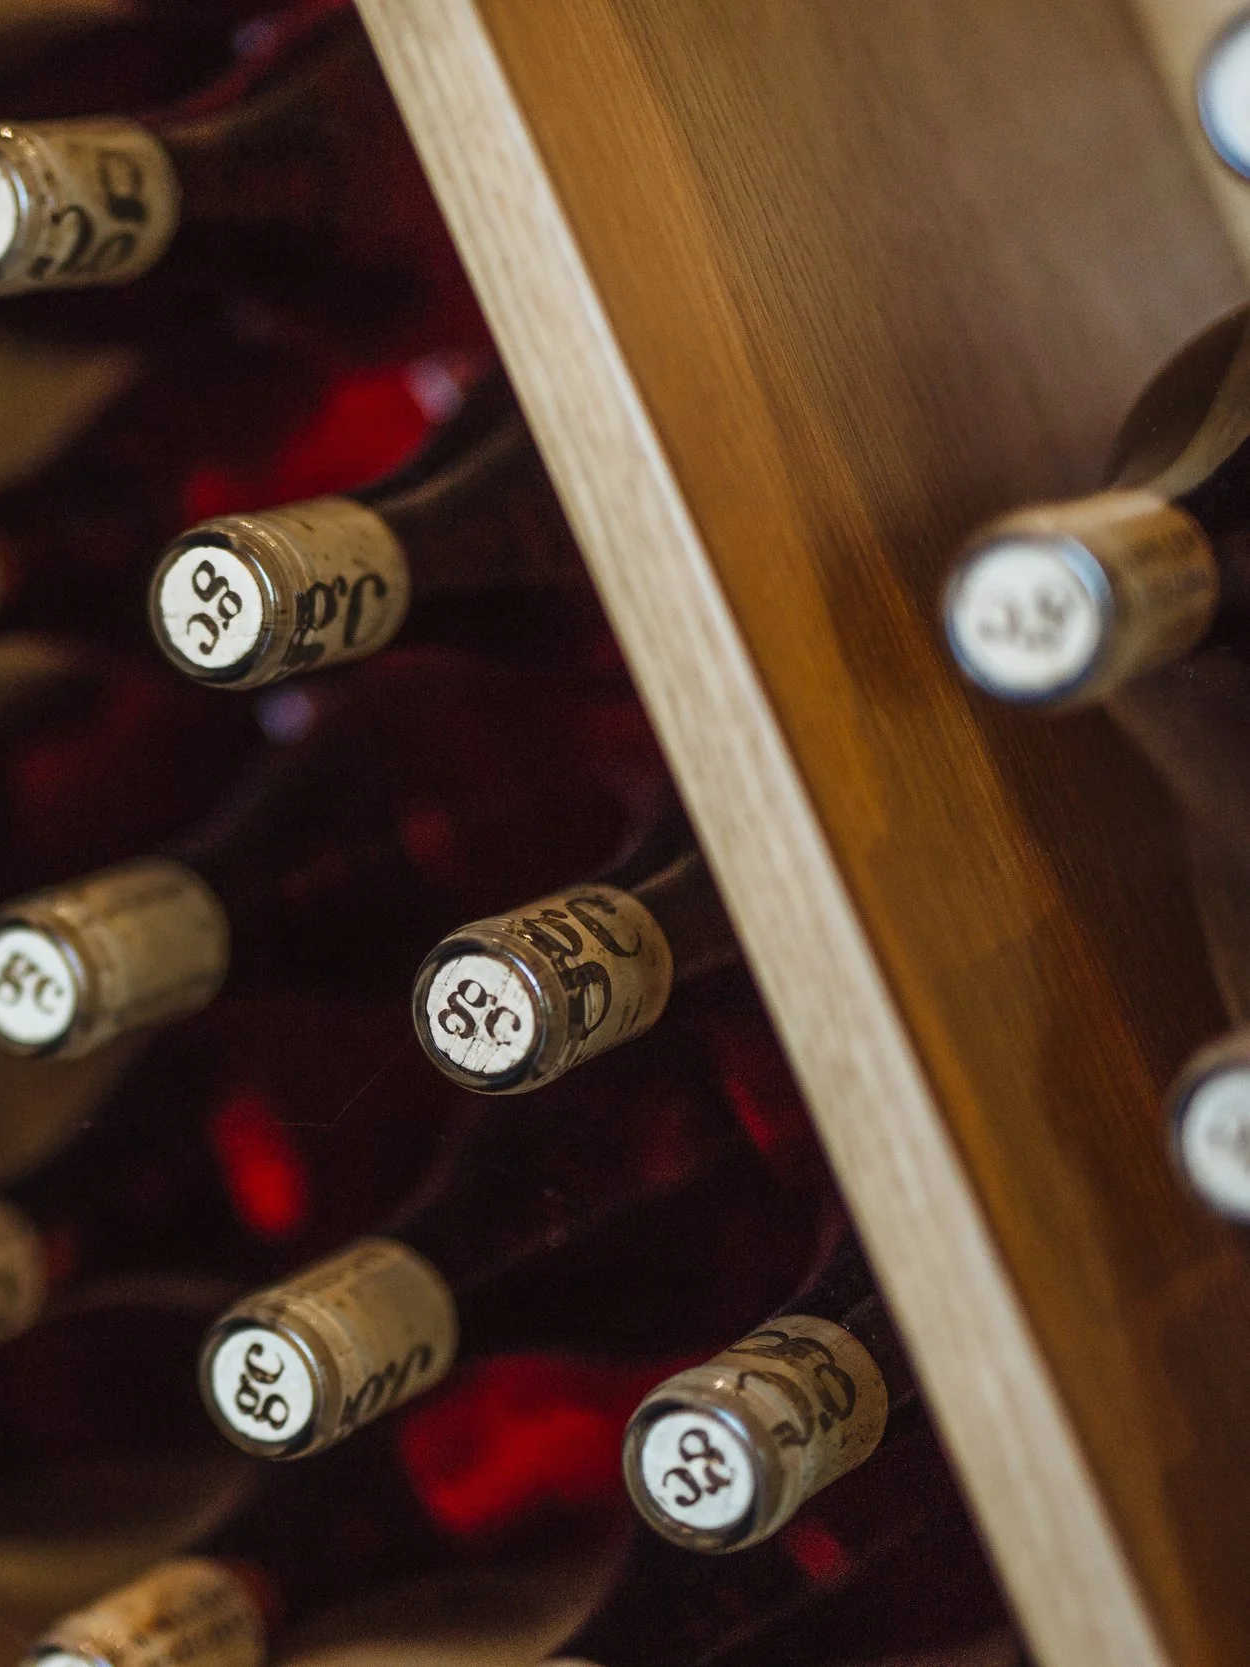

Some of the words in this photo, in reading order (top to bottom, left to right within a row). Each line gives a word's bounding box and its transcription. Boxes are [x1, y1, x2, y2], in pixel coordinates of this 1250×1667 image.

[186, 559, 243, 656] gc
[437, 978, 522, 1047] gc
[234, 1342, 290, 1431] gc
[661, 1427, 735, 1508] gc
